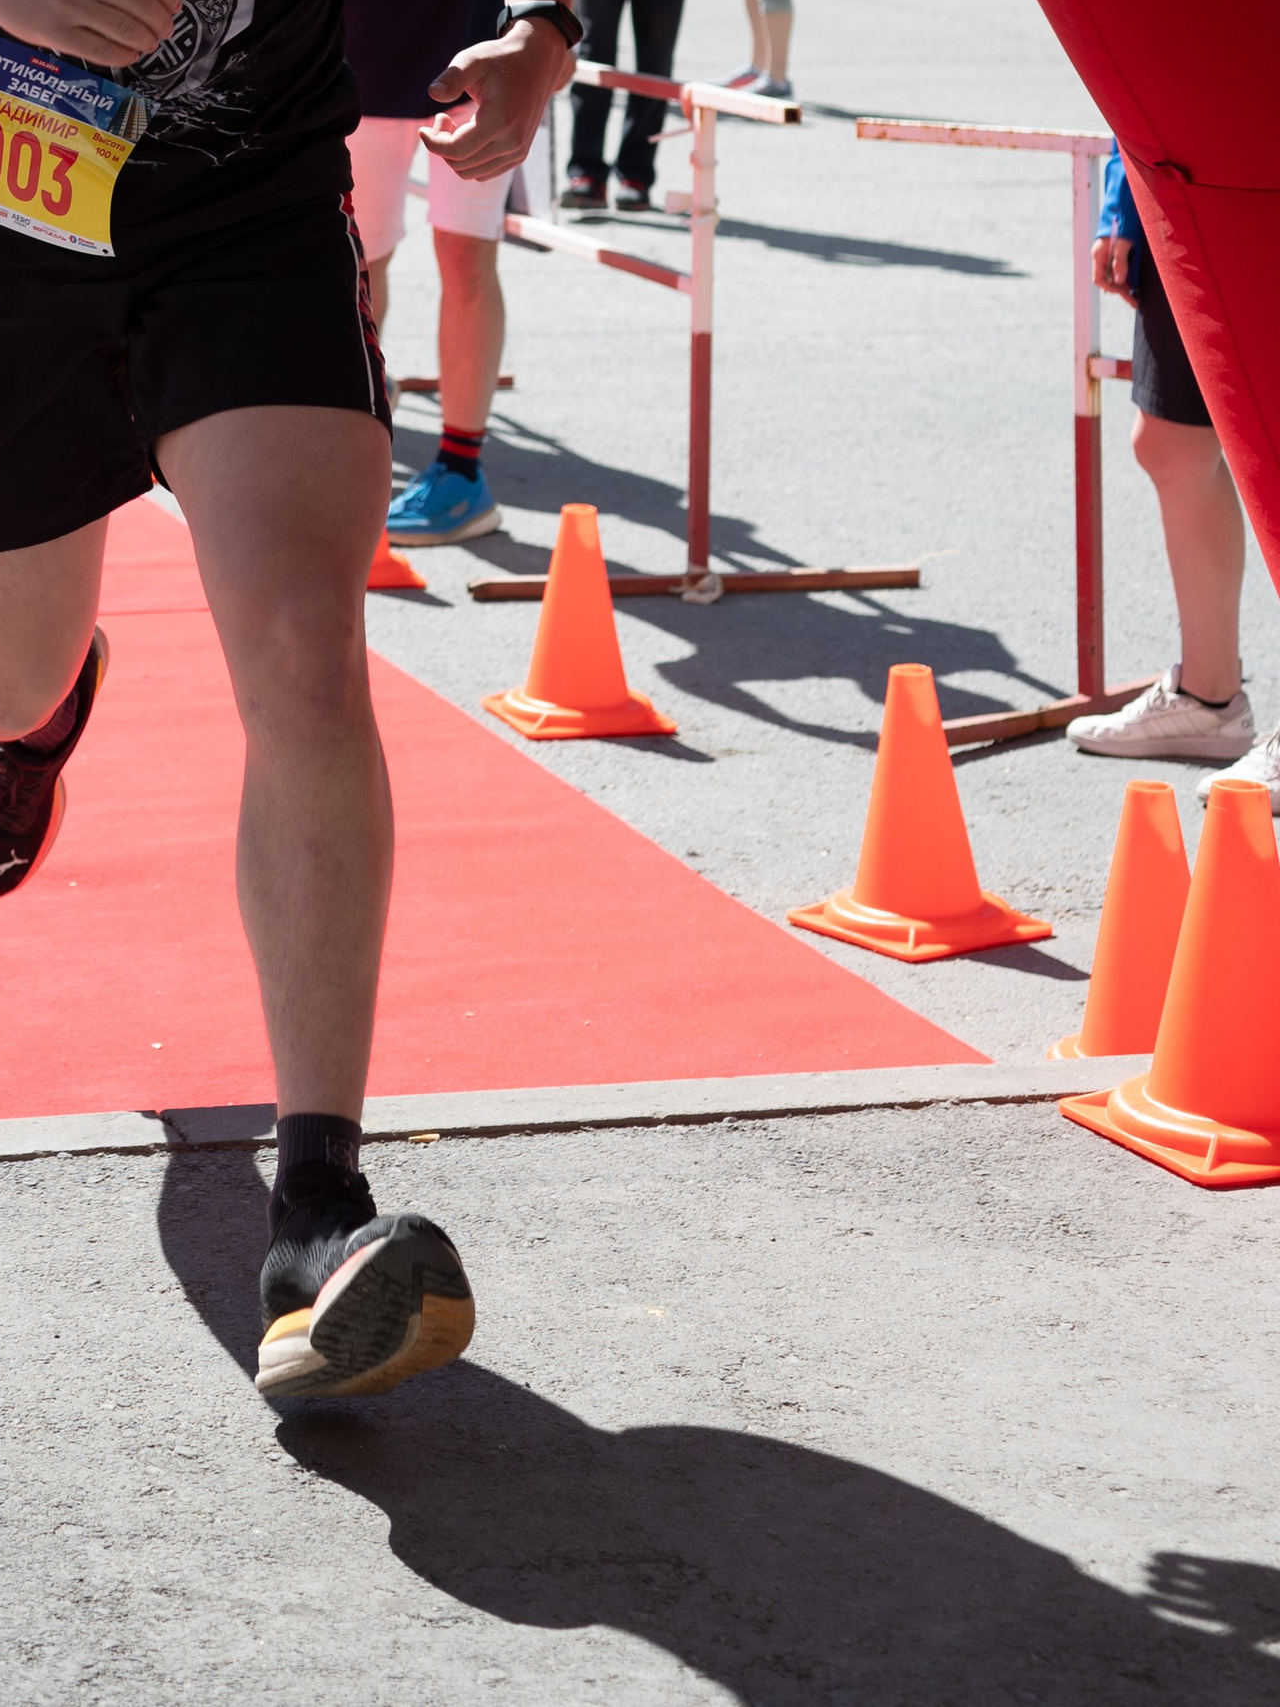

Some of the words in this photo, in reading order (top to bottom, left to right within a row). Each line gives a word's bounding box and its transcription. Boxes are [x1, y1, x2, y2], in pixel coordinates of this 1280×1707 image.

[7, 76, 65, 105] ЗАБЕГ
[92, 132, 127, 152] Высота
[96, 147, 112, 159] 100
[11, 213, 31, 226] AERO
